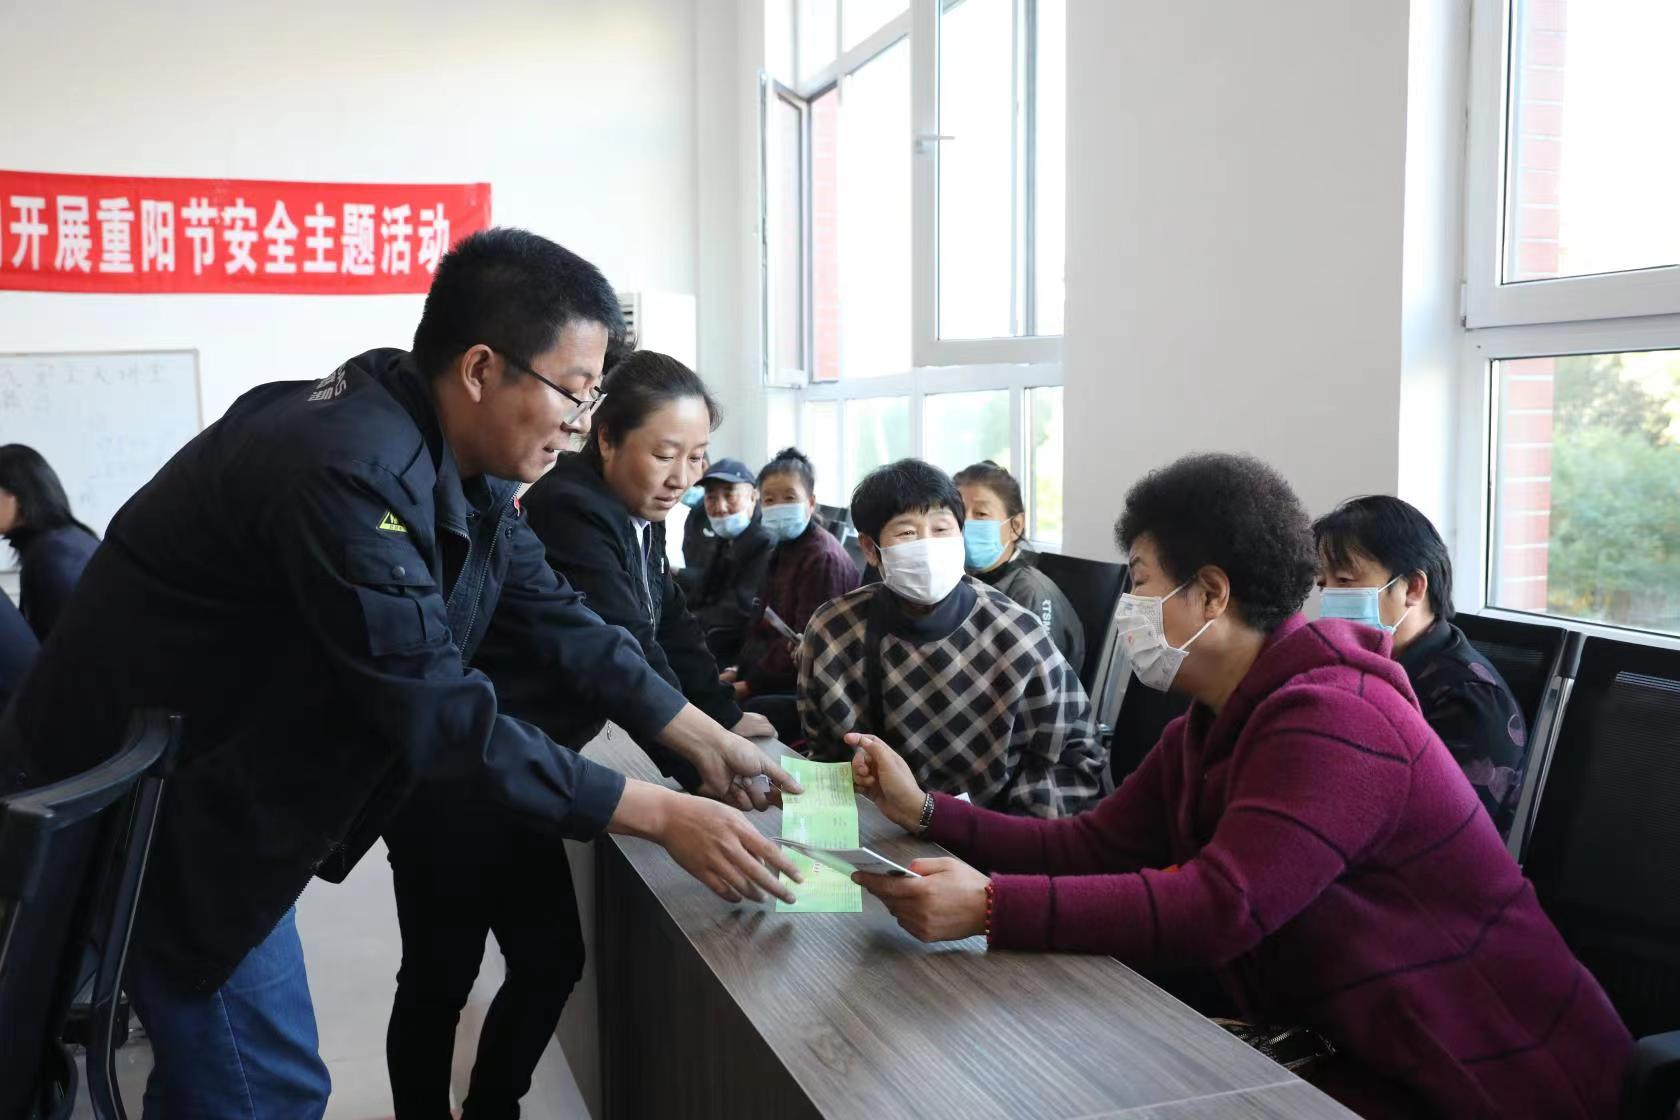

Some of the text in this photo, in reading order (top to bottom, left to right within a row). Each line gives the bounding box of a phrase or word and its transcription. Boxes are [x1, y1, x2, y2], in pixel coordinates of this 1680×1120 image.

[0, 194, 450, 276] 开展重阳节安全主题活动
